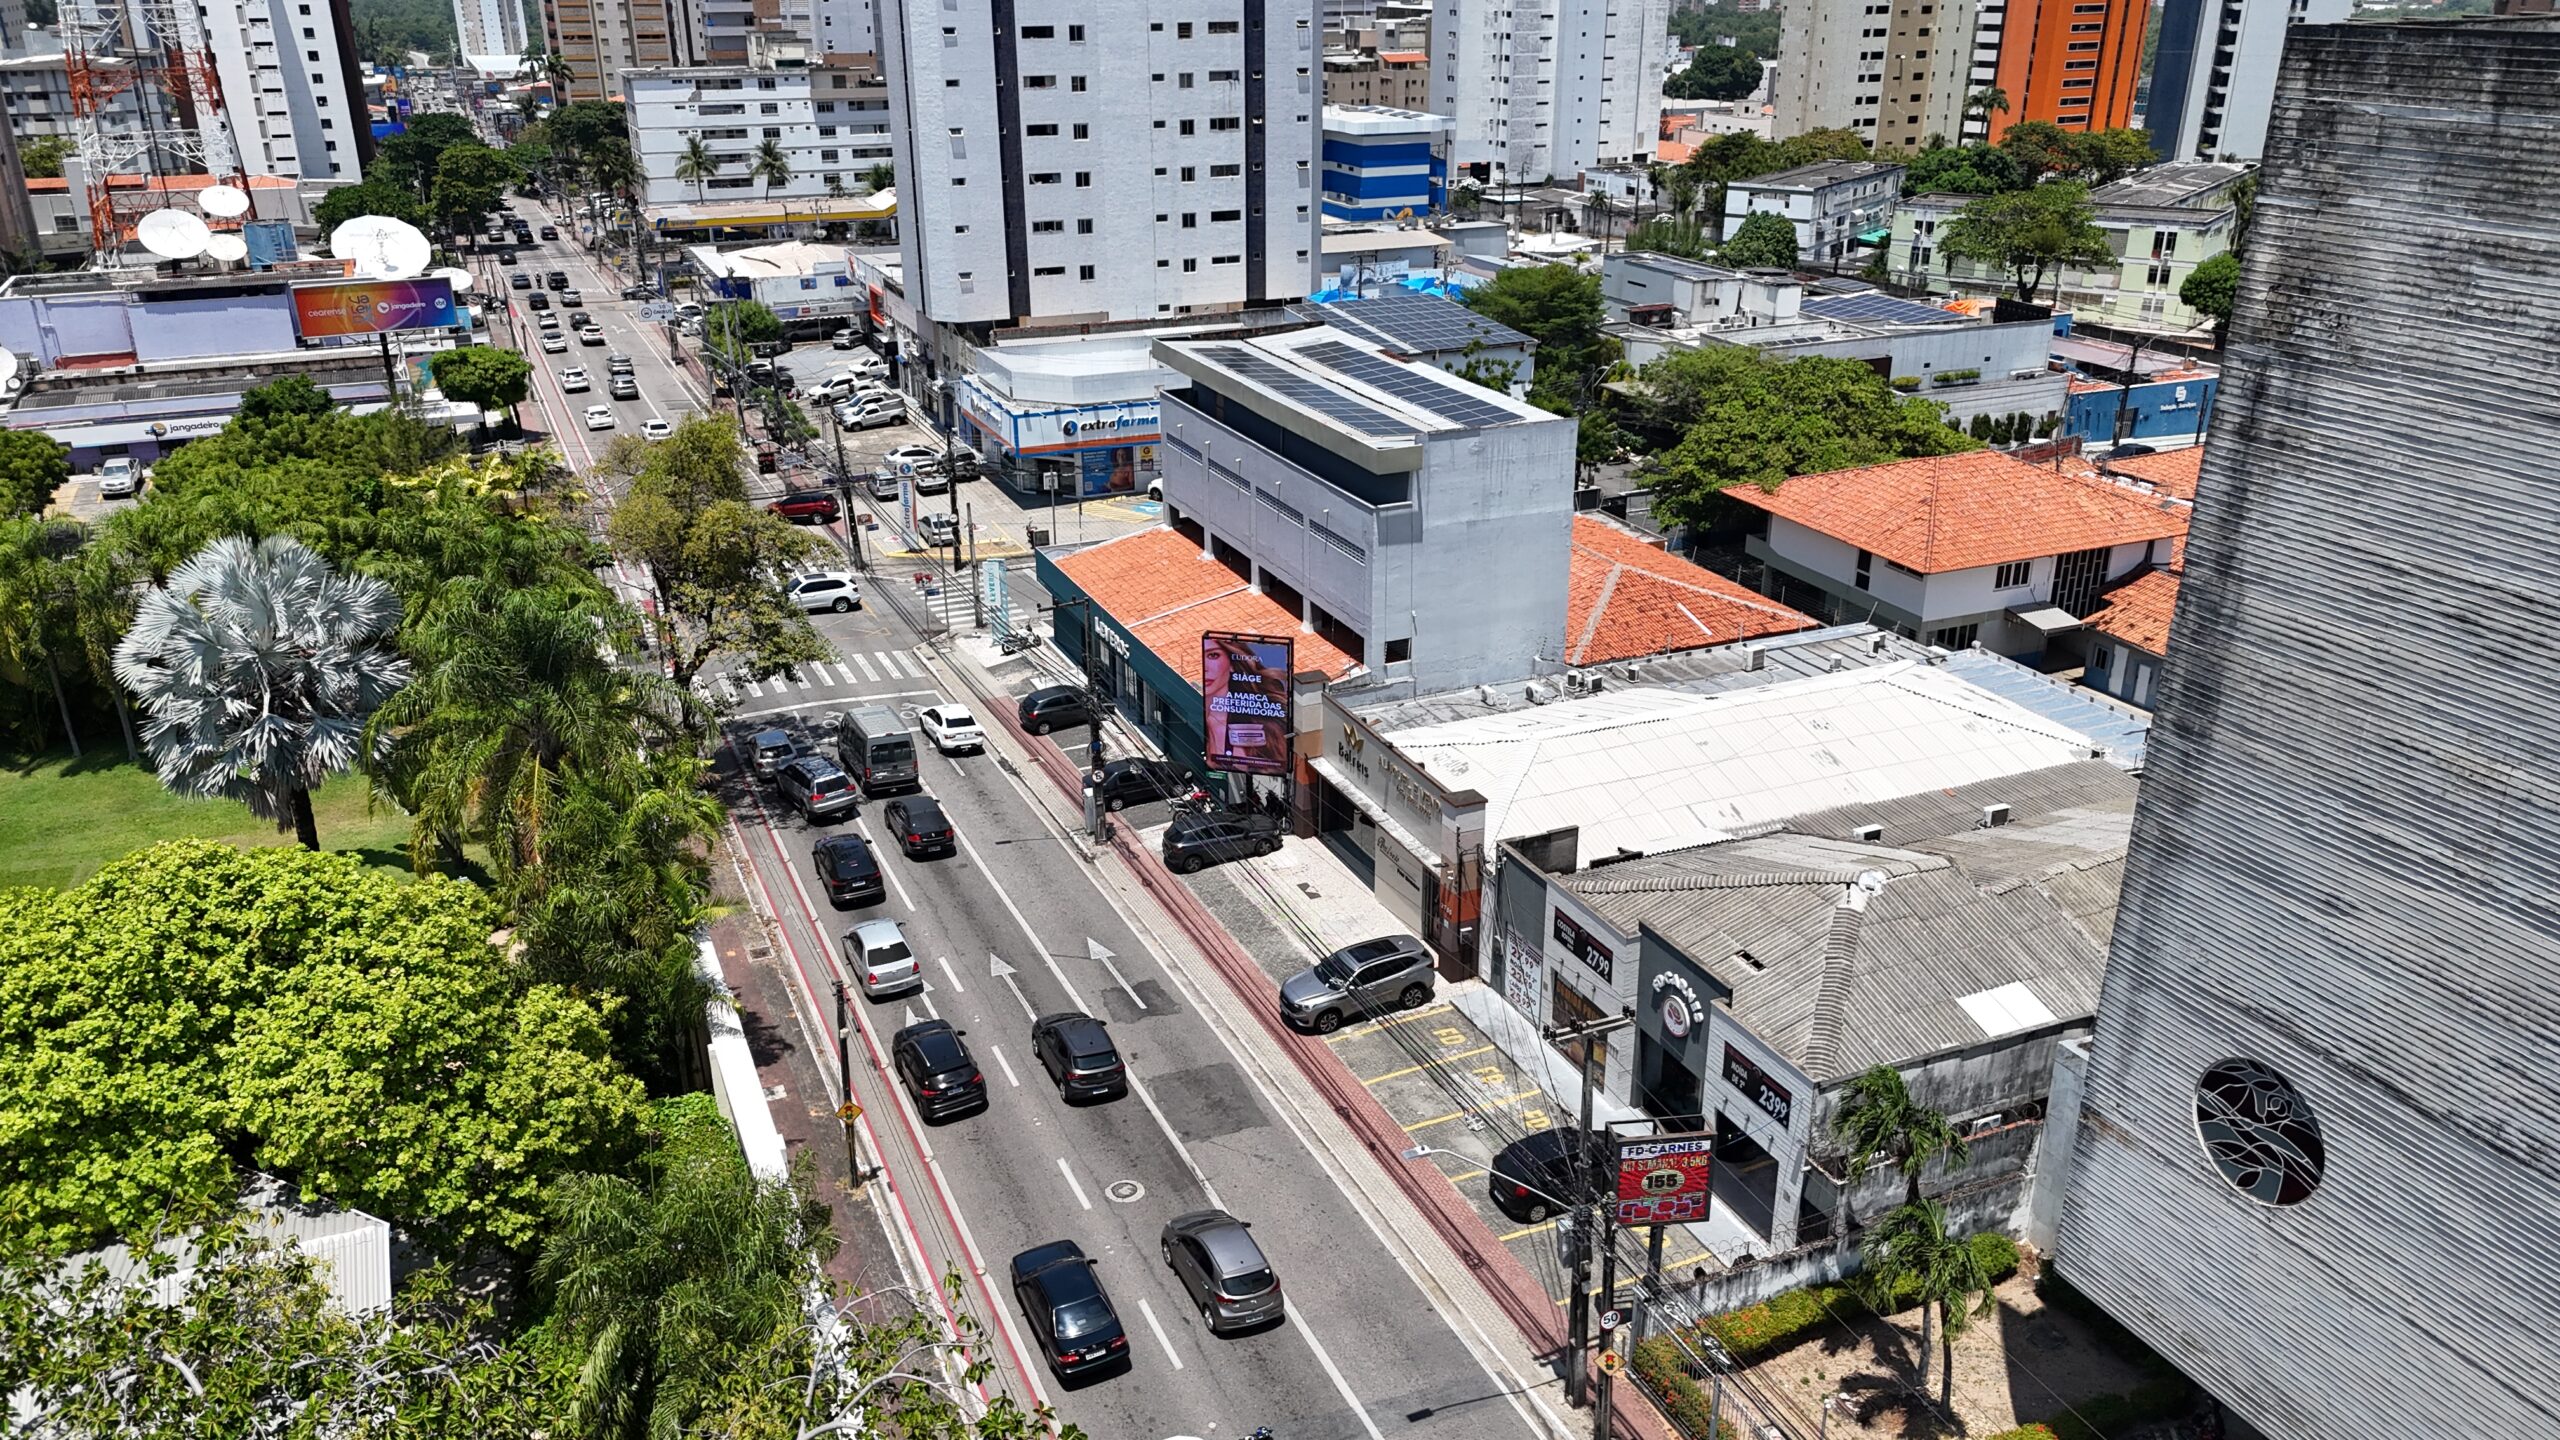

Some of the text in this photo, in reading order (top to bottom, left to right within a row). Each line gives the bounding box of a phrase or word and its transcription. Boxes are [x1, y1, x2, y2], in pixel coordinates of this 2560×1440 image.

[391, 301, 426, 311] jangadeiro
[170, 421, 220, 433] jangadeiro
[1080, 415, 1158, 433] extrafarma
[901, 482, 912, 529] extrafarma
[1231, 653, 1264, 663] EUDORA
[1234, 691, 1268, 702] MARCA
[1212, 697, 1282, 711] PREFERIDA DAS
[1209, 704, 1286, 718] CONSUMIDORAS
[1628, 1142, 1703, 1156] FD-CARNES
[1622, 1160, 1636, 1172] KIT
[1645, 1173, 1678, 1189] 155
[1603, 1313, 1618, 1325] 50
